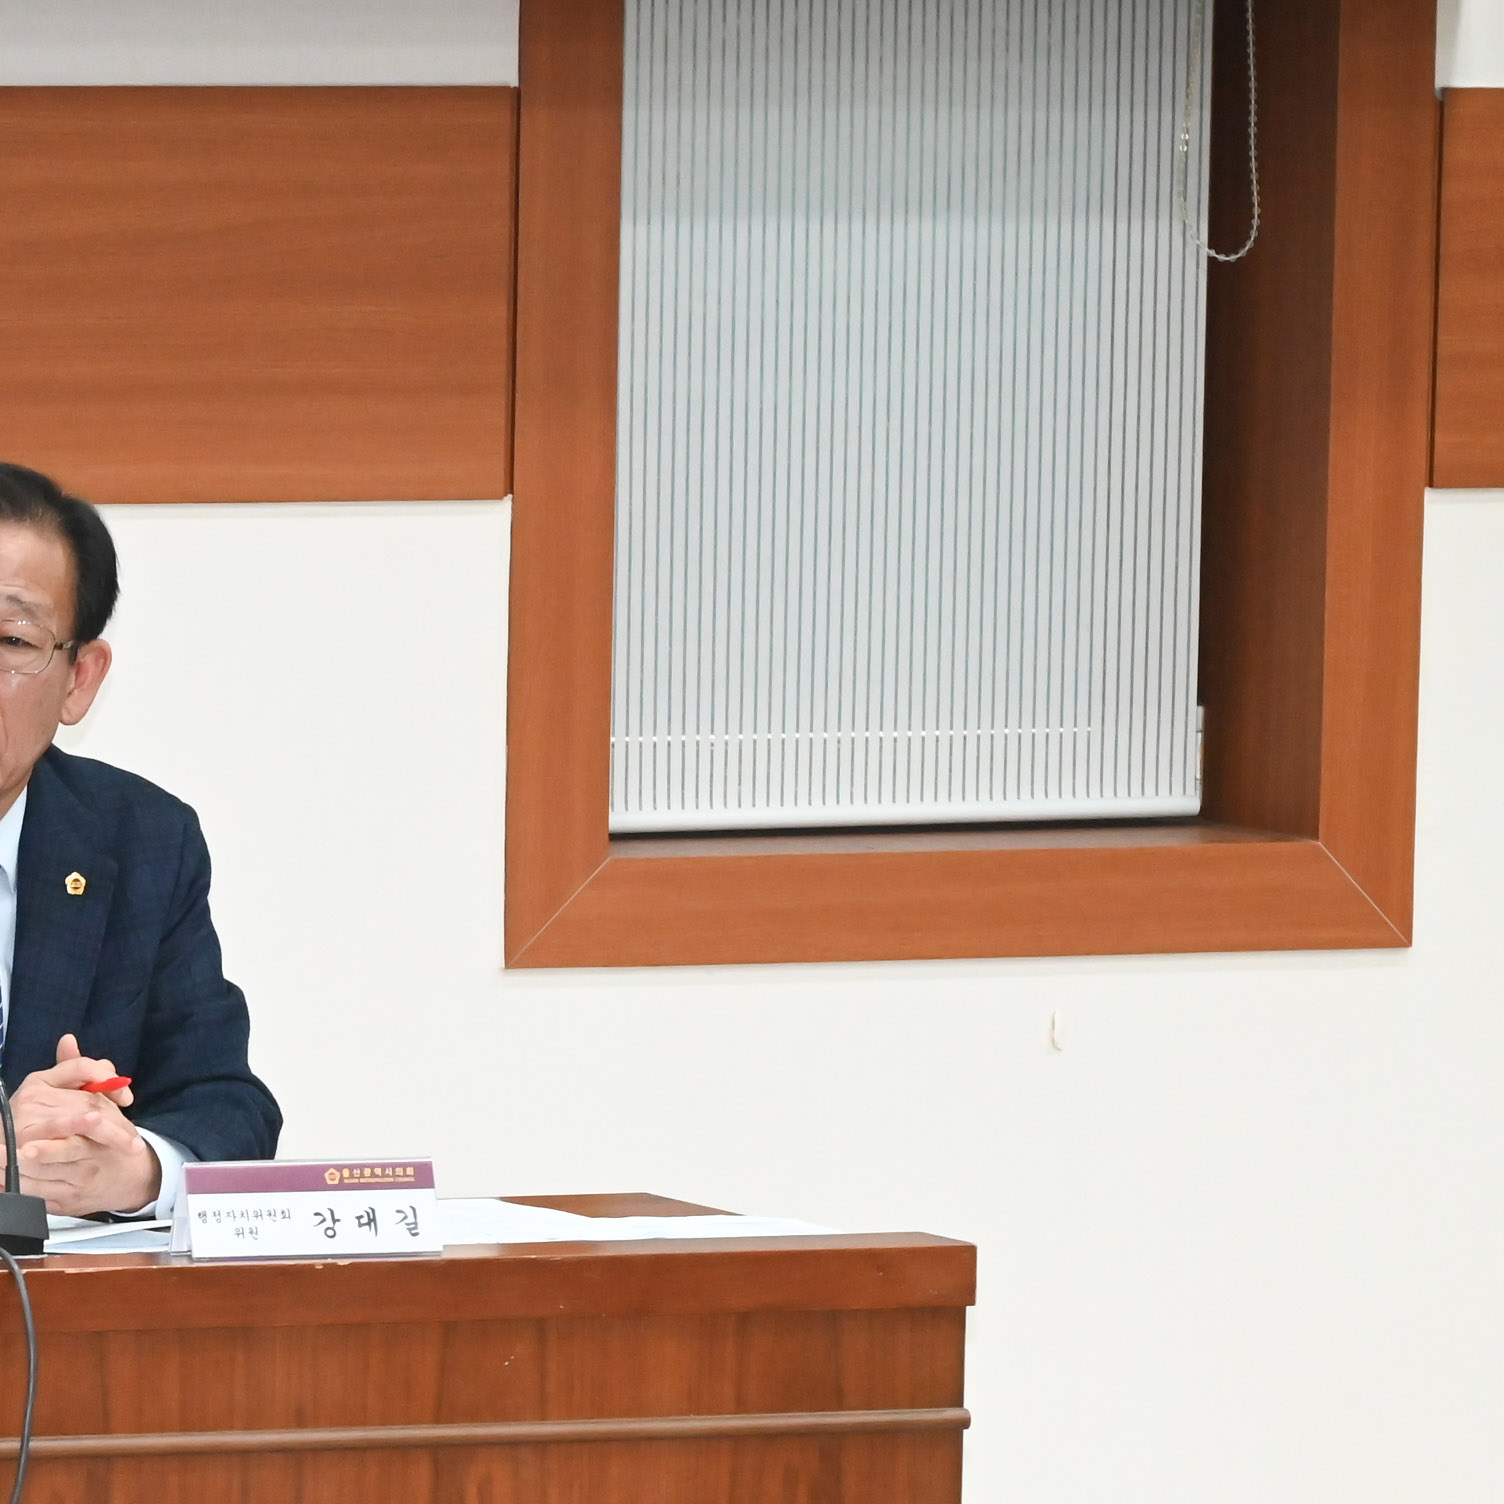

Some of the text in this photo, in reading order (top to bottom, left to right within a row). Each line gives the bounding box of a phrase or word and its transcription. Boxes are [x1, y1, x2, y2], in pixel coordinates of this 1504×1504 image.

[197, 1207, 292, 1224] 행정자치위원회
[313, 1205, 420, 1239] 강대길
[234, 1226, 259, 1240] 위원
